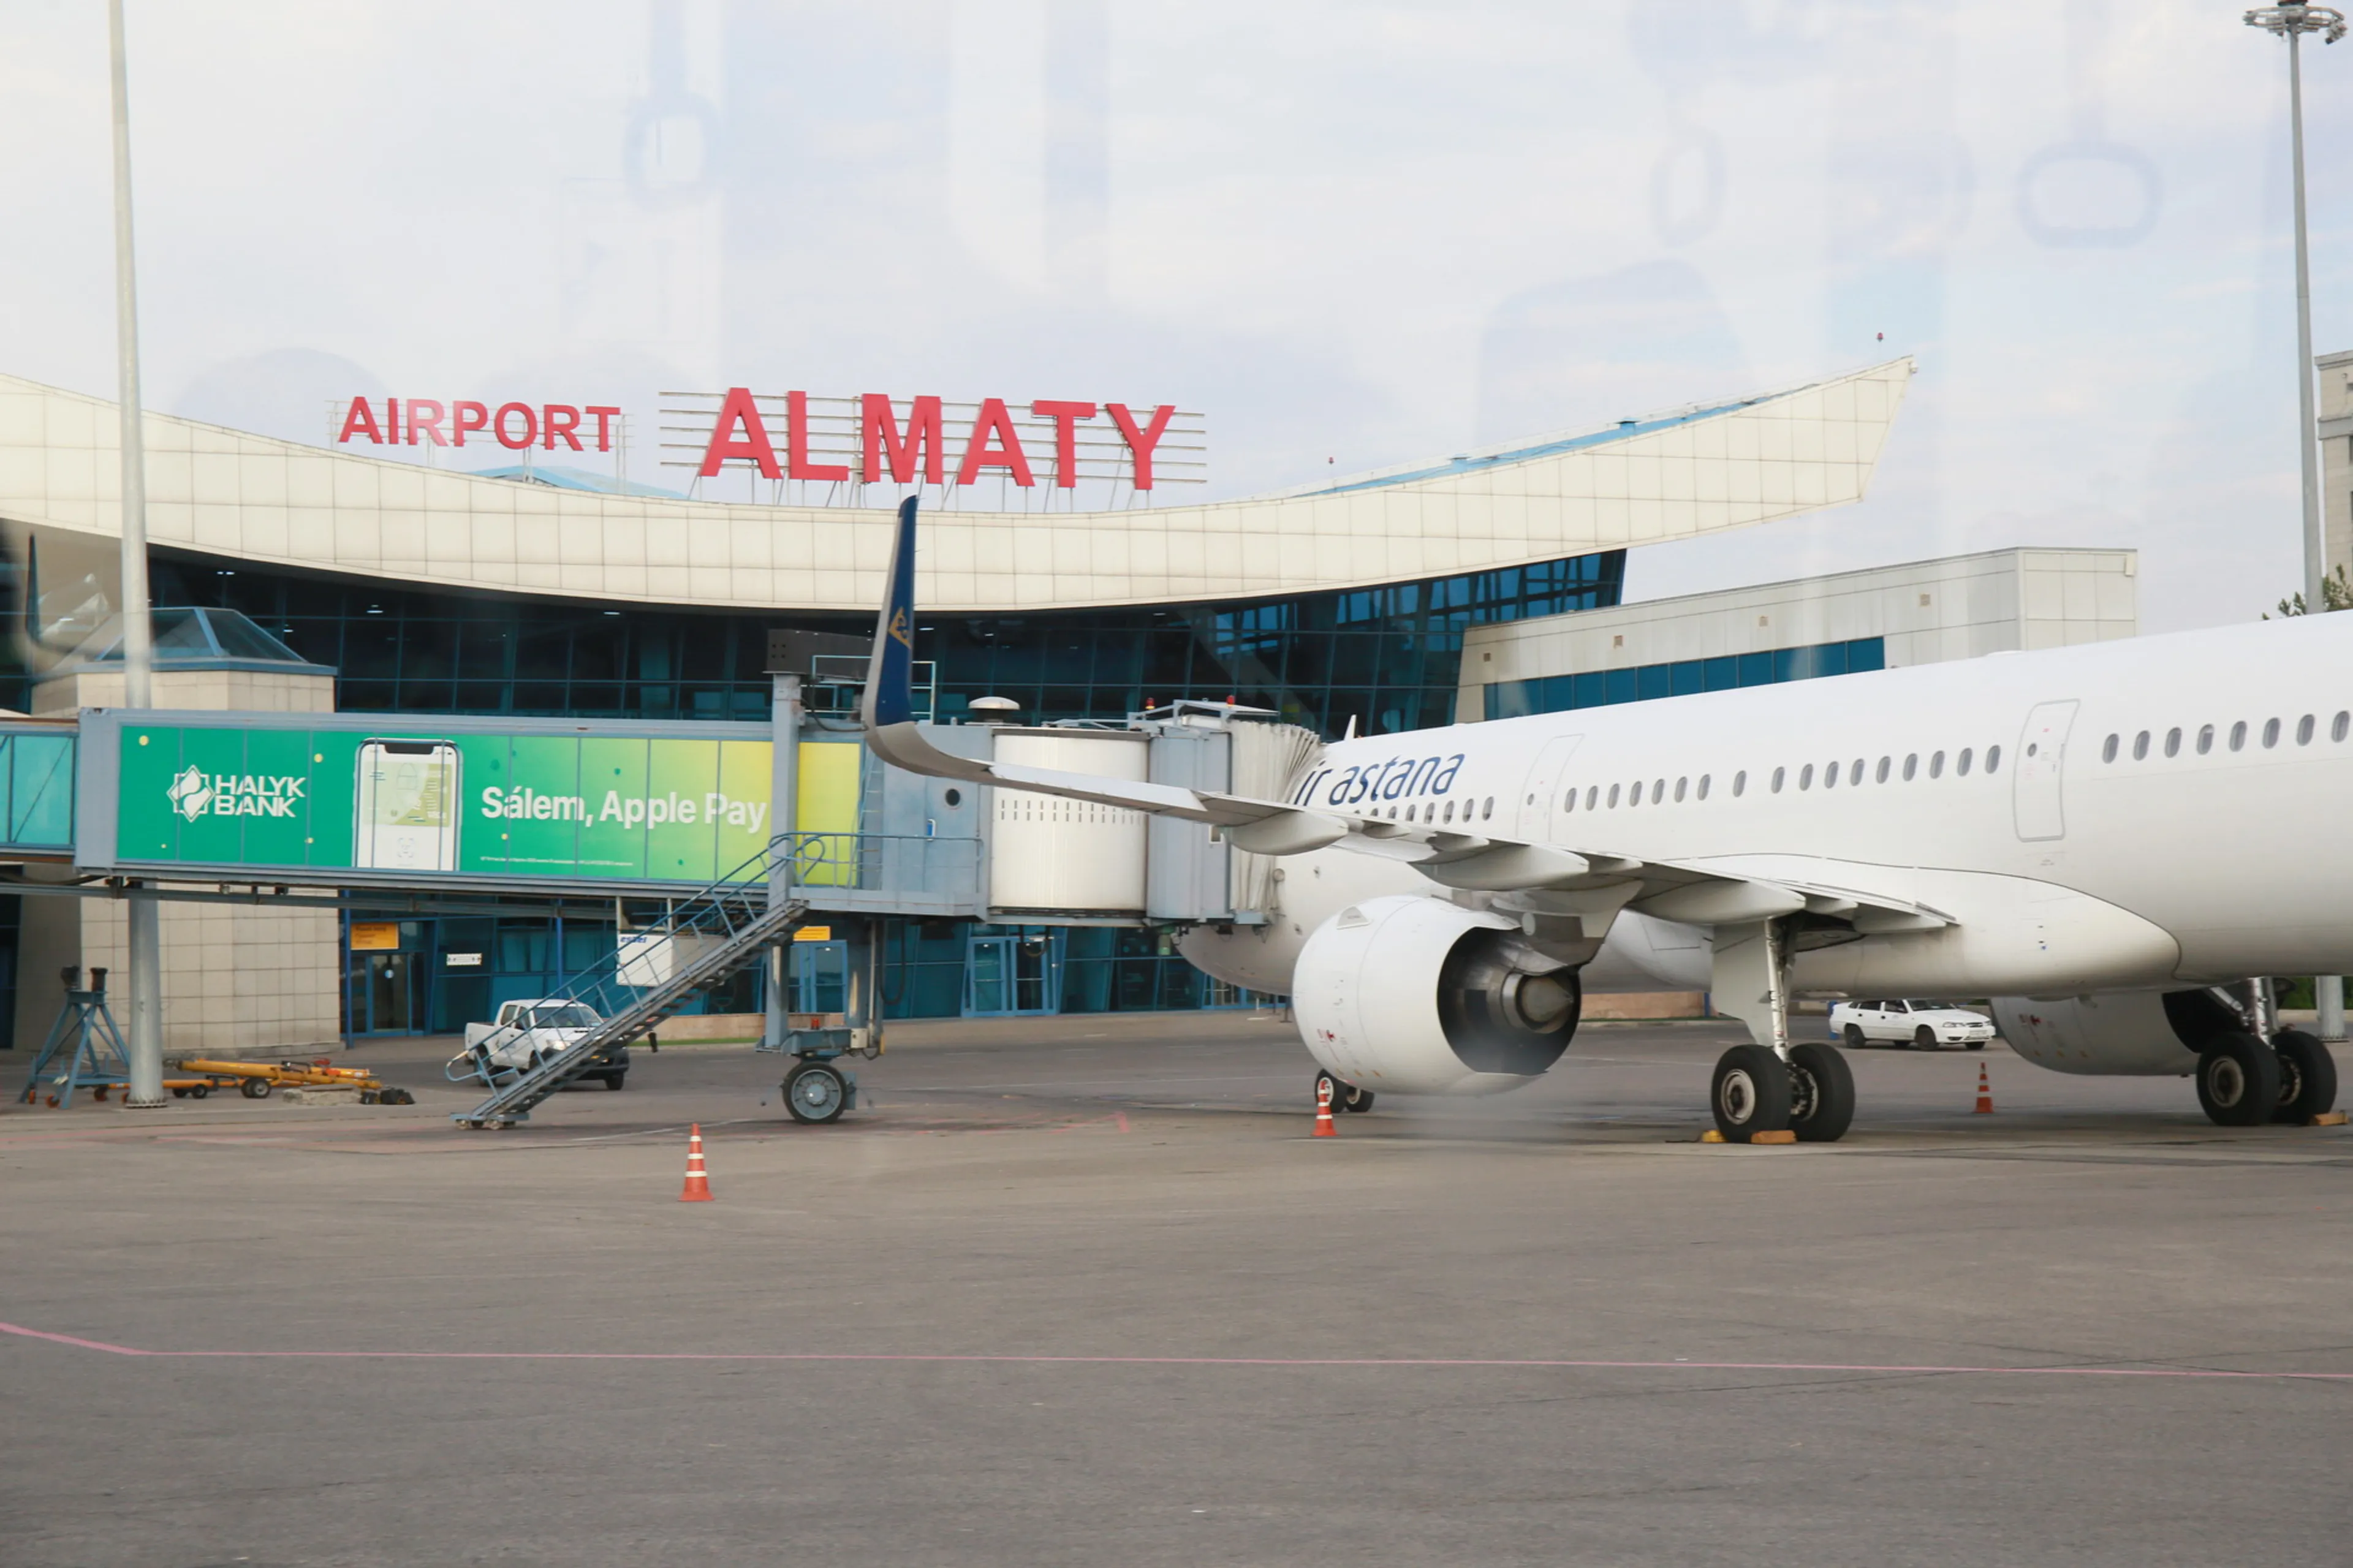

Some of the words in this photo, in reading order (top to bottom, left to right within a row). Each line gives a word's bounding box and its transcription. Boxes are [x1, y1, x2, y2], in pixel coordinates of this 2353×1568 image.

[338, 396, 621, 452] AIRPORT
[699, 387, 1176, 490] ALMATY
[215, 774, 306, 797] HALYK
[1293, 760, 1333, 806] ir
[1328, 753, 1465, 806] astana
[214, 795, 297, 817] BANK
[480, 786, 594, 827] Sálem,
[599, 790, 697, 829] Apple
[705, 792, 767, 834] Pay
